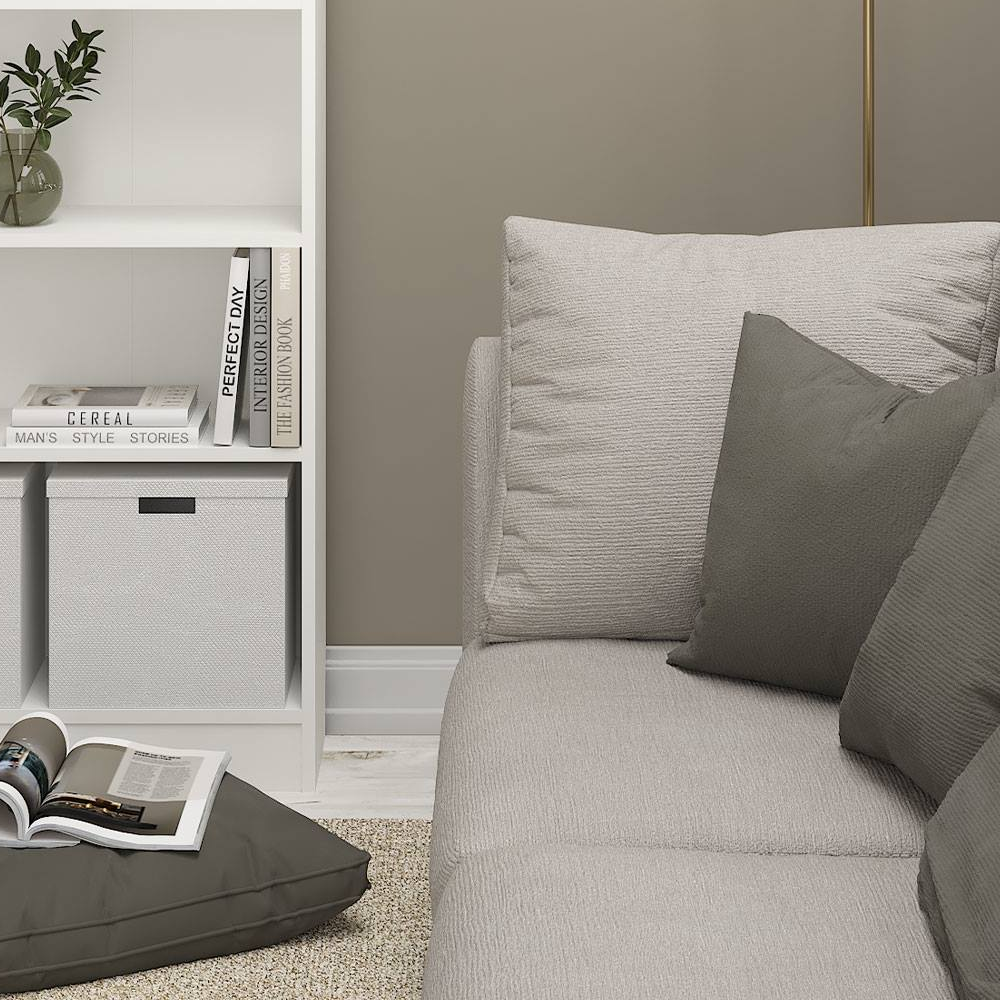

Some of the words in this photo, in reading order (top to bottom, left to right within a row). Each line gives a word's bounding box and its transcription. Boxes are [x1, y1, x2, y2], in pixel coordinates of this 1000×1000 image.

[230, 286, 244, 318] DAY
[253, 278, 267, 335] DESIGN
[277, 317, 292, 352] BOOK
[222, 322, 240, 397] PERFECT
[253, 340, 267, 412] INTERIOR
[277, 355, 292, 408] FASHION
[67, 412, 133, 426] CEREAL
[277, 411, 292, 436] THE
[15, 432, 57, 443] MAN'S
[72, 432, 115, 443] STYLE
[130, 432, 189, 443] STORIES
